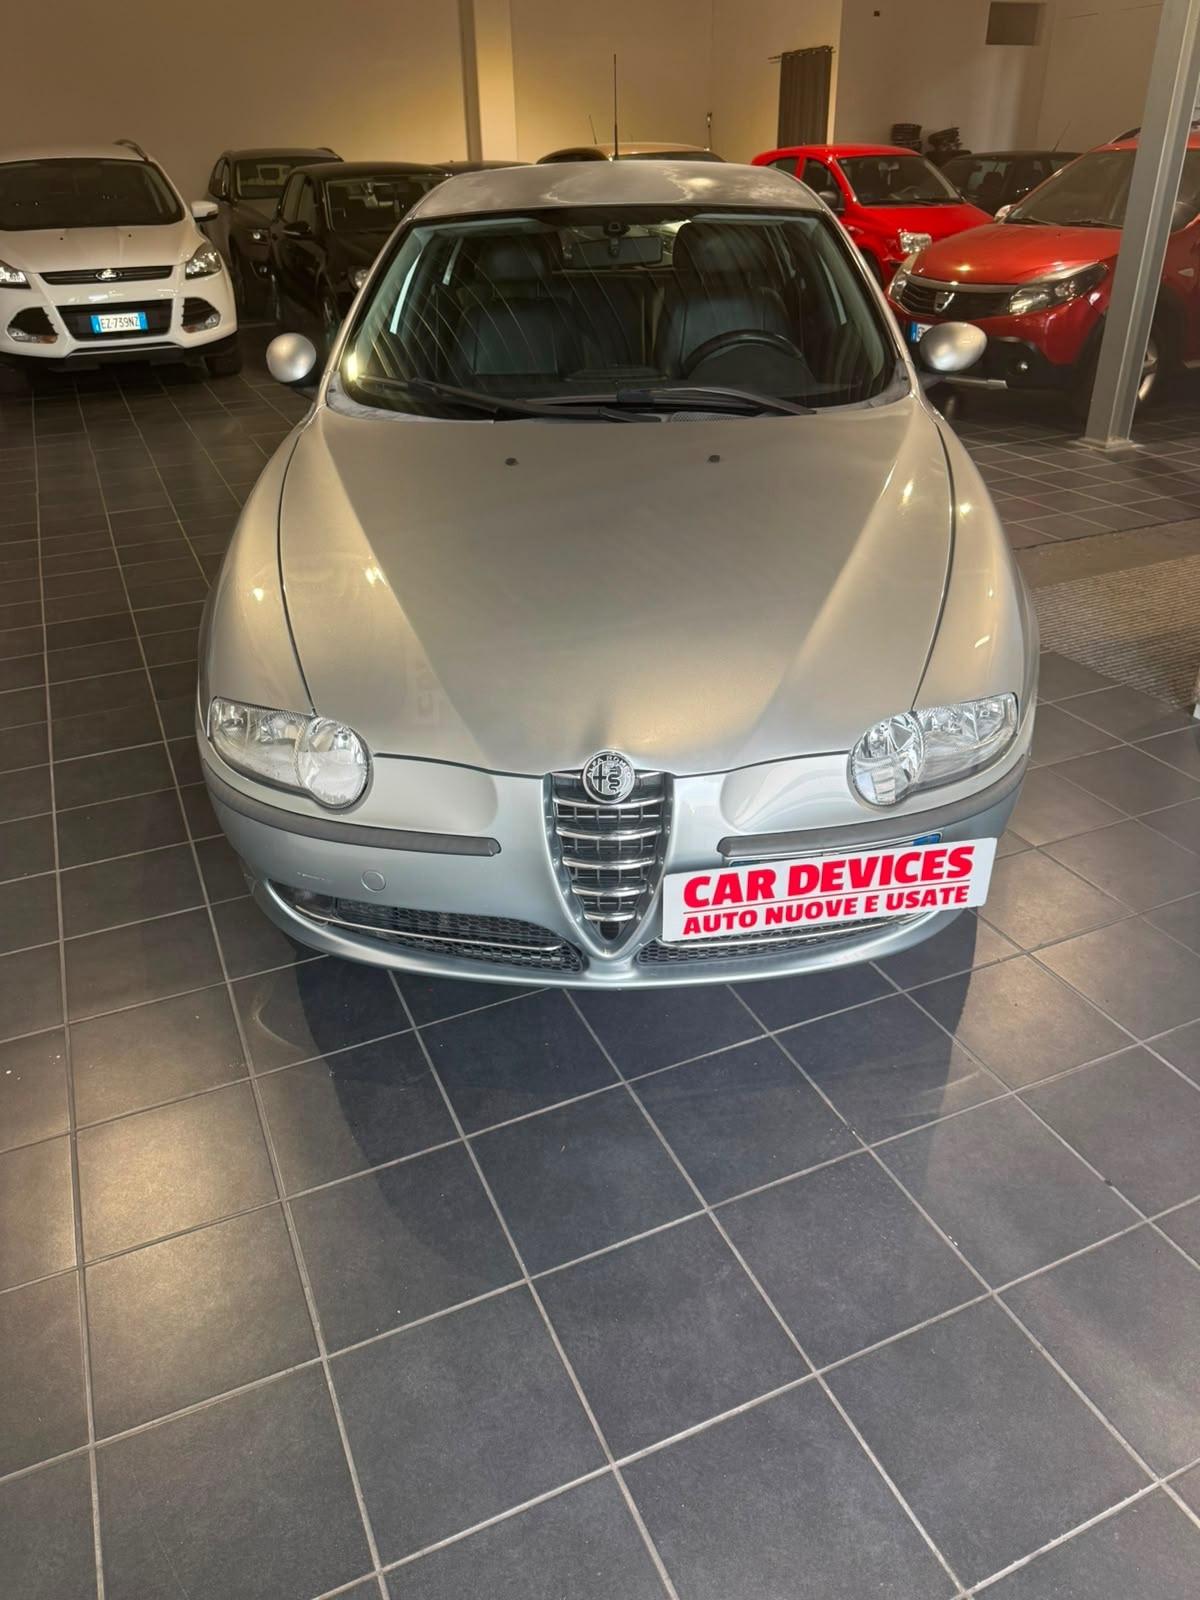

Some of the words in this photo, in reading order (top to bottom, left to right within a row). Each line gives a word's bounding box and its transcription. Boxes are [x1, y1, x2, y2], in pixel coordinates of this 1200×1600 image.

[682, 868, 778, 910] CAR
[787, 845, 975, 898] DEVICES
[682, 909, 759, 936] AUTO
[764, 897, 859, 926] NUOVE
[863, 894, 880, 914] E
[885, 884, 970, 912] USATE
